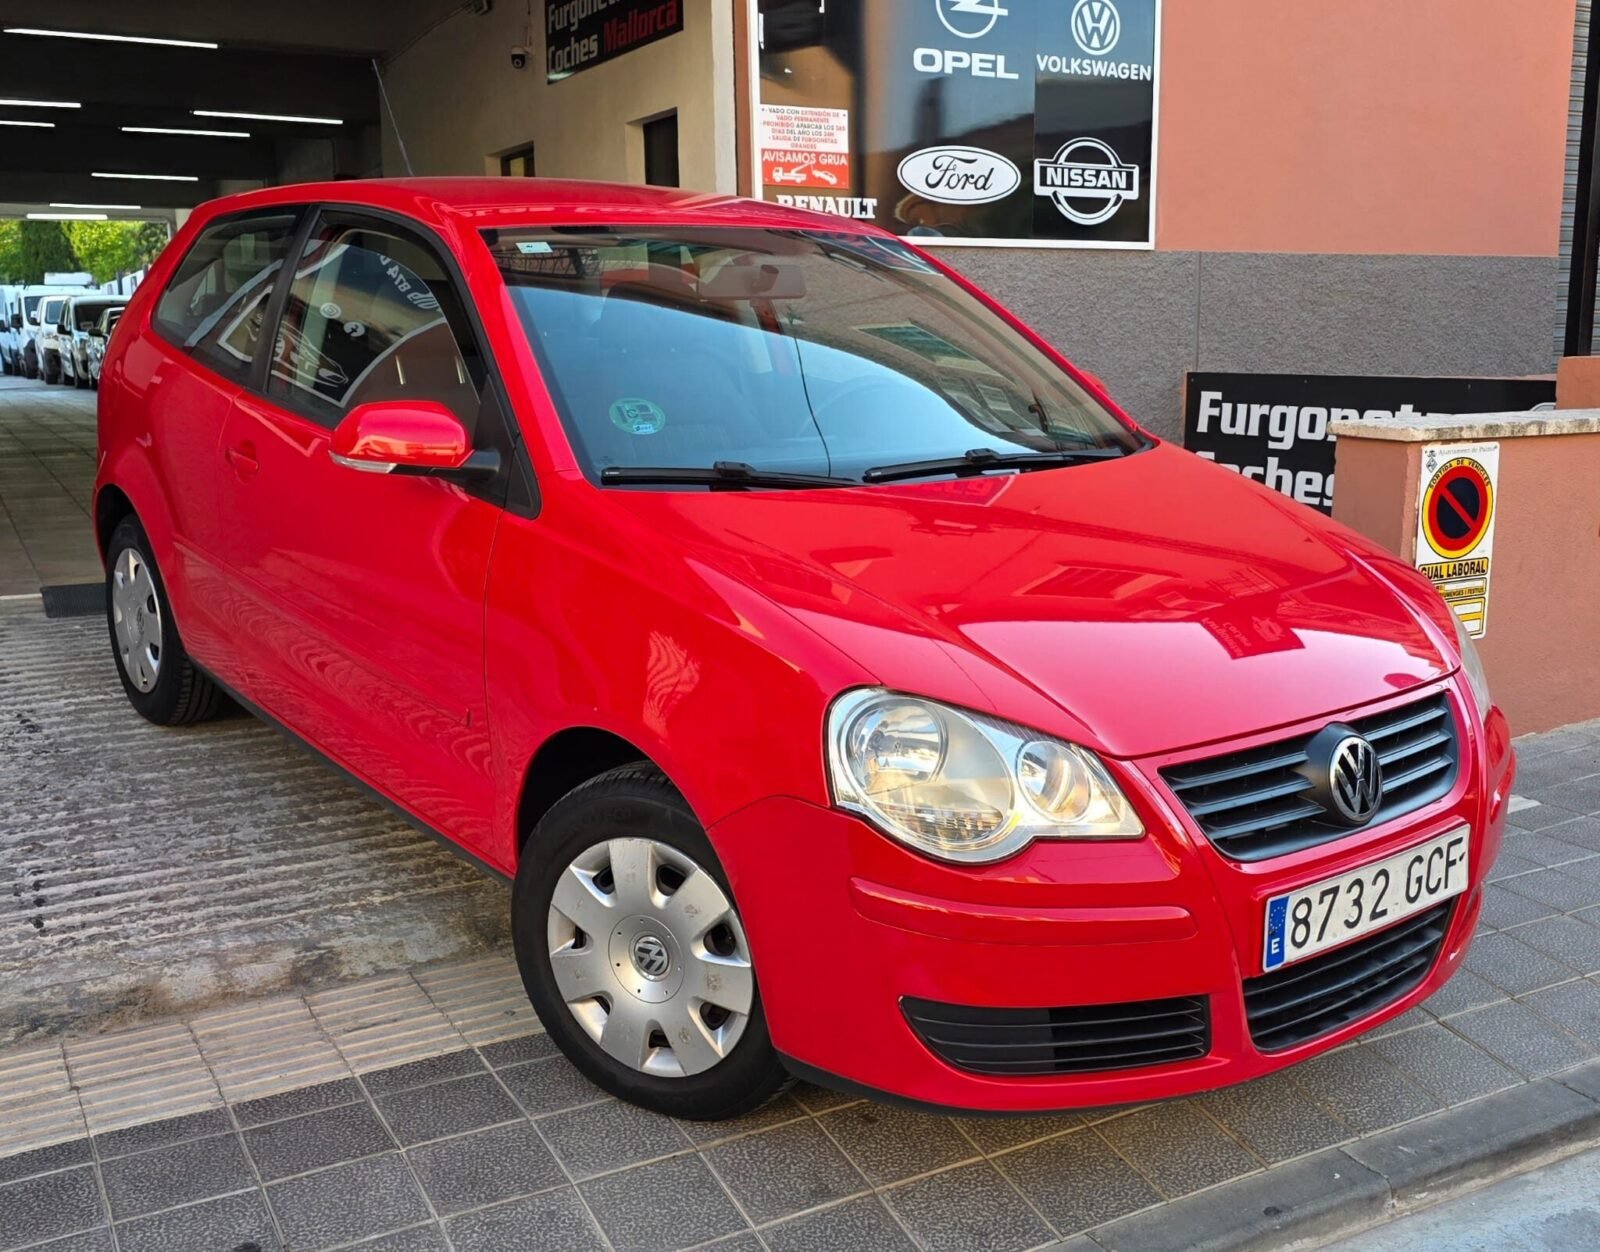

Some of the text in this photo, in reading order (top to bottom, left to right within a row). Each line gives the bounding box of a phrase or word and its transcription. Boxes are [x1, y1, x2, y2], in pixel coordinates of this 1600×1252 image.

[547, 0, 678, 73] Coches Mallorca
[913, 47, 1019, 80] OPEL
[1036, 54, 1152, 82] VOLKSWAGEN
[762, 120, 795, 128] PROHIBIDO
[794, 116, 829, 124] PERMANENTE
[801, 136, 838, 144] FURGONETAS
[763, 151, 848, 166] AVISAMOS GRUA
[925, 154, 1127, 192] Ford NISSAN
[1429, 464, 1453, 488] SORTIDA
[1468, 461, 1491, 487] VEHICLES
[1447, 560, 1486, 577] LABORAL
[1290, 837, 1464, 949] 8732 GCF
[1271, 938, 1280, 954] E
